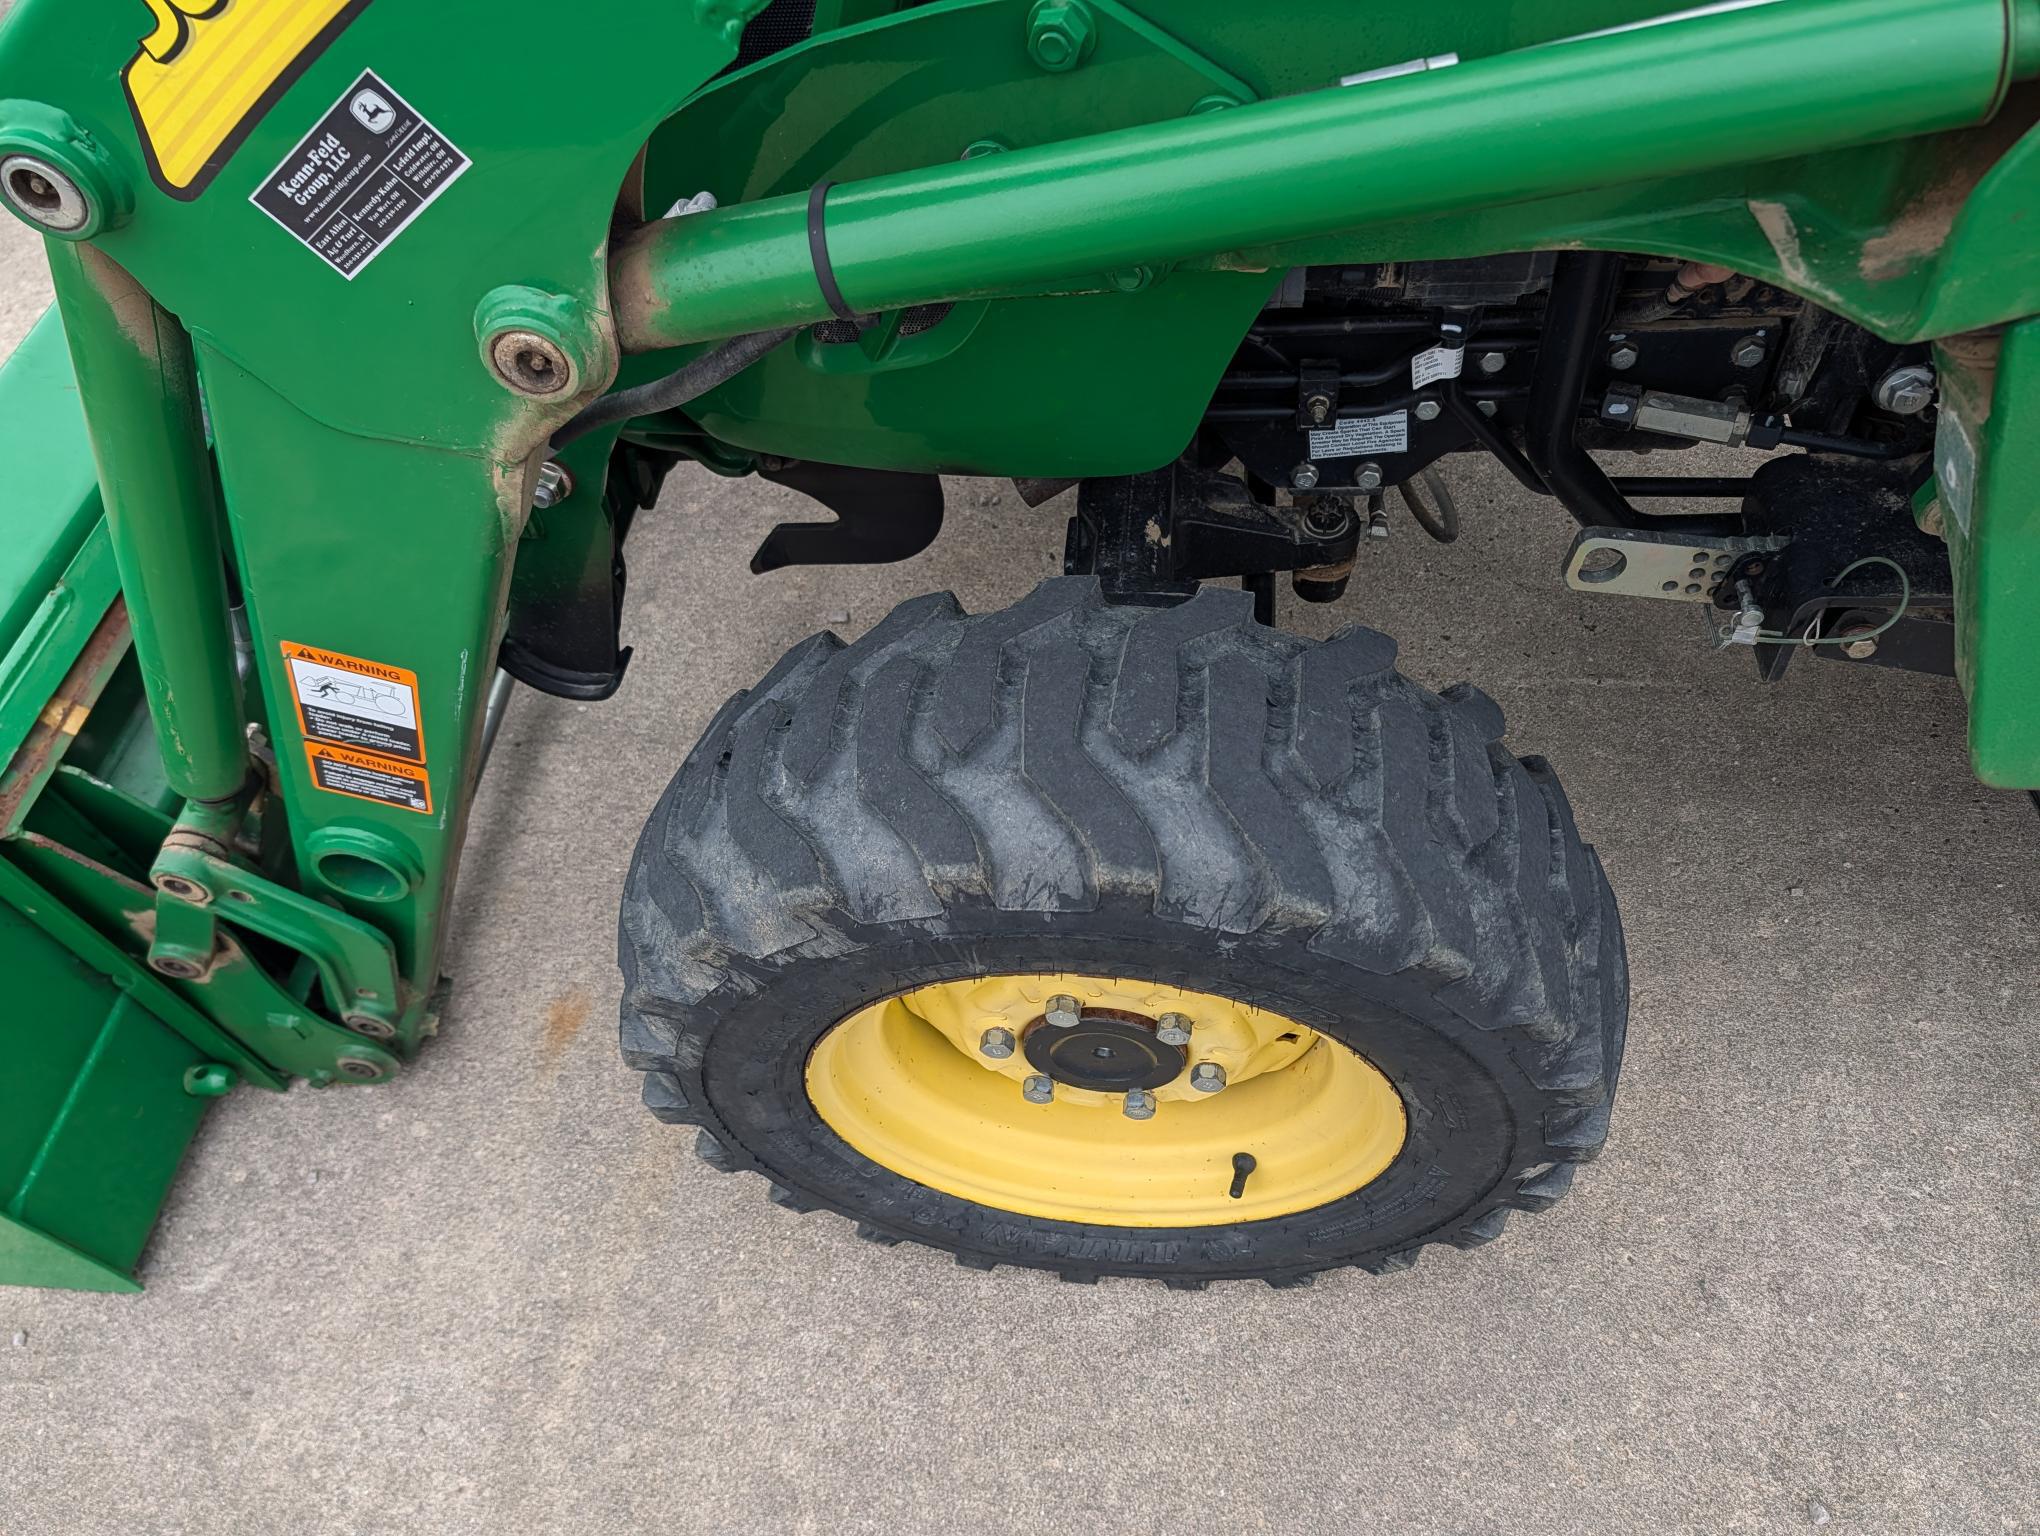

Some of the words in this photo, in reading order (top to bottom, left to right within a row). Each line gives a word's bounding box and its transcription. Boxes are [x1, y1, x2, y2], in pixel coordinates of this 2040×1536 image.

[278, 133, 340, 198] Kenn-Feld
[393, 148, 415, 171] Lefeld
[412, 132, 432, 151] Impl.
[404, 151, 432, 177] Coldwater,
[430, 141, 440, 151] OH
[436, 149, 446, 159] OH
[294, 173, 333, 205] Group,
[325, 147, 350, 172] LLC
[304, 154, 371, 223] www.kennfeldgroup.com
[352, 178, 398, 221] Kennedy-Kuhn
[368, 212, 379, 221] Van
[377, 200, 393, 213] Wert,
[390, 191, 400, 200] OH
[316, 235, 331, 249] East
[329, 219, 348, 236] Allen
[327, 247, 339, 257] Ag
[340, 226, 357, 242] Turf
[319, 654, 400, 680] WARNING
[340, 753, 415, 776] WARNING
